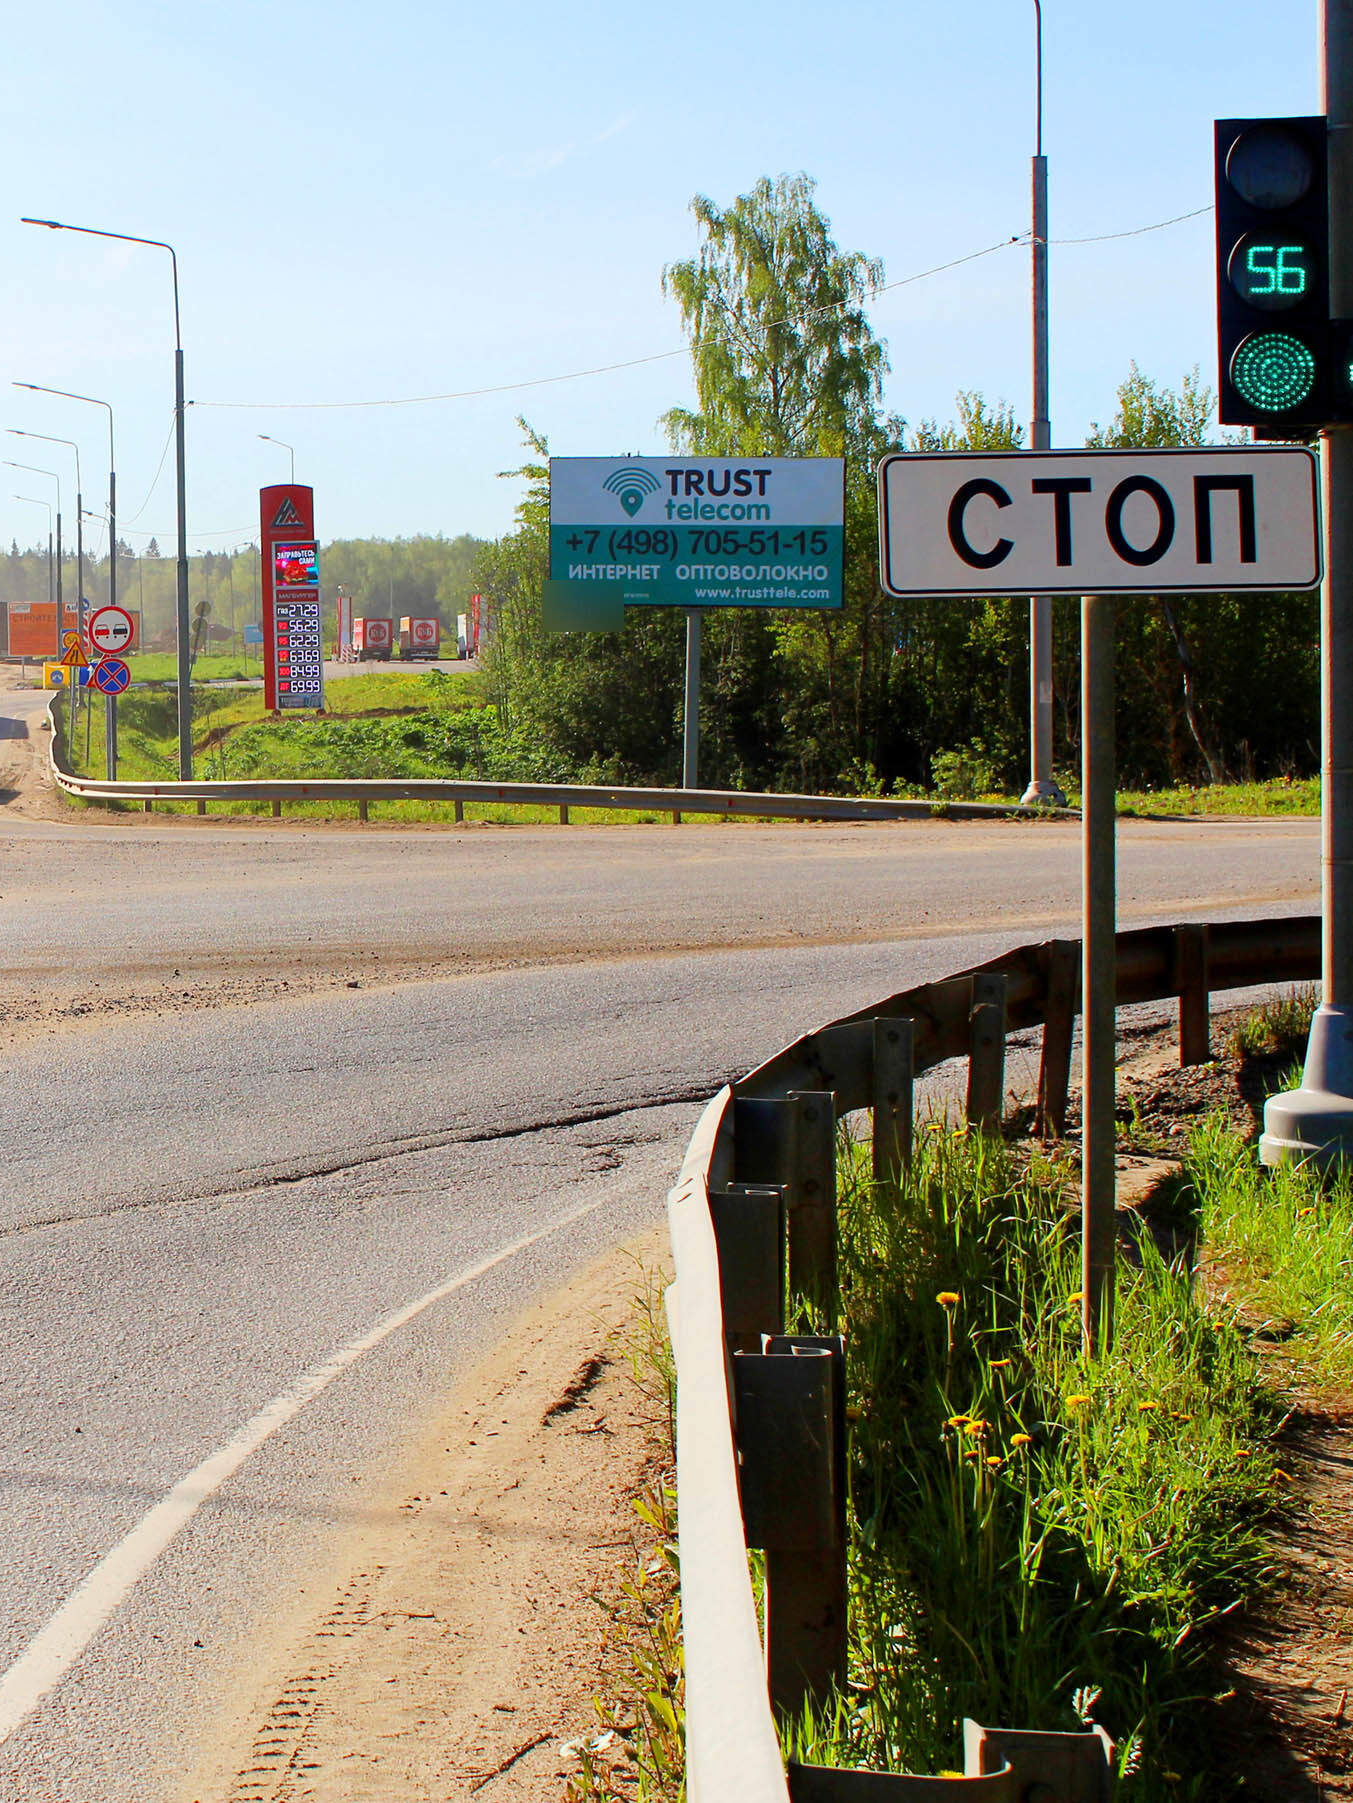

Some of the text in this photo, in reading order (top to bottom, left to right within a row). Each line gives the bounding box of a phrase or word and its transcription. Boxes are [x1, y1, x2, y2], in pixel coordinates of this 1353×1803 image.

[1247, 246, 1305, 293] 56
[665, 469, 772, 497] TRUST
[665, 498, 771, 521] telecom
[947, 474, 1257, 570] СТОП
[565, 530, 828, 561] +7 (498) 705-51-15
[569, 564, 829, 582] ИНТЕРНЕТ ОПТОВОЛОКНО
[695, 586, 830, 600] www.trusttele.com
[289, 604, 318, 617] 27.29
[289, 620, 318, 632] 56.29
[289, 635, 319, 647] 62.29
[290, 650, 319, 662] 63.69
[290, 665, 319, 677] 84.99
[291, 681, 320, 693] 69.99
